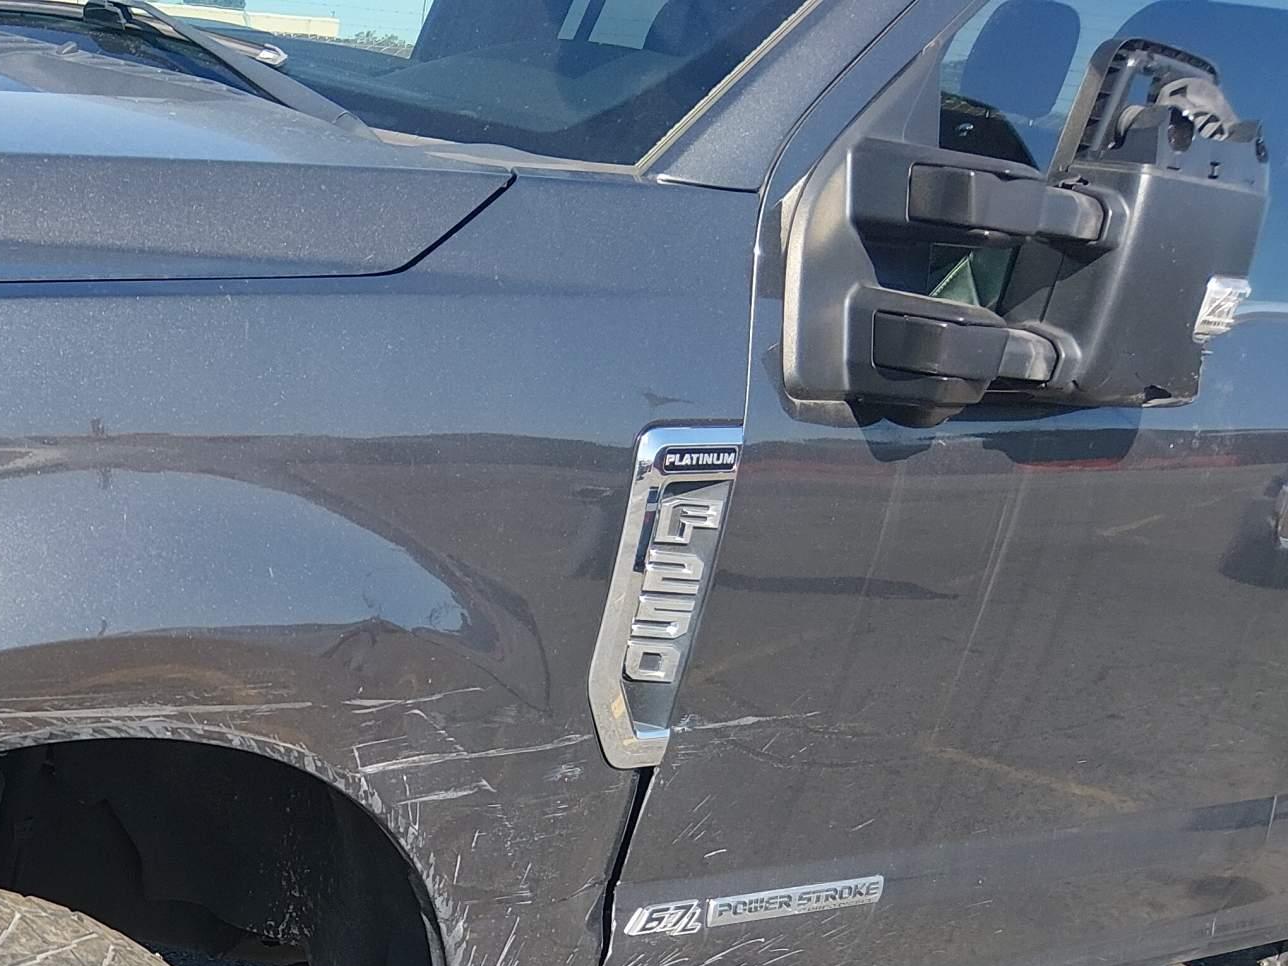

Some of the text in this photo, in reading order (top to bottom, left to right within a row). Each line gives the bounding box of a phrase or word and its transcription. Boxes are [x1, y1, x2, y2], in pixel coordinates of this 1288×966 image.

[665, 452, 736, 467] PLATINUM
[717, 893, 793, 918] POWER
[796, 880, 880, 906] STROKE
